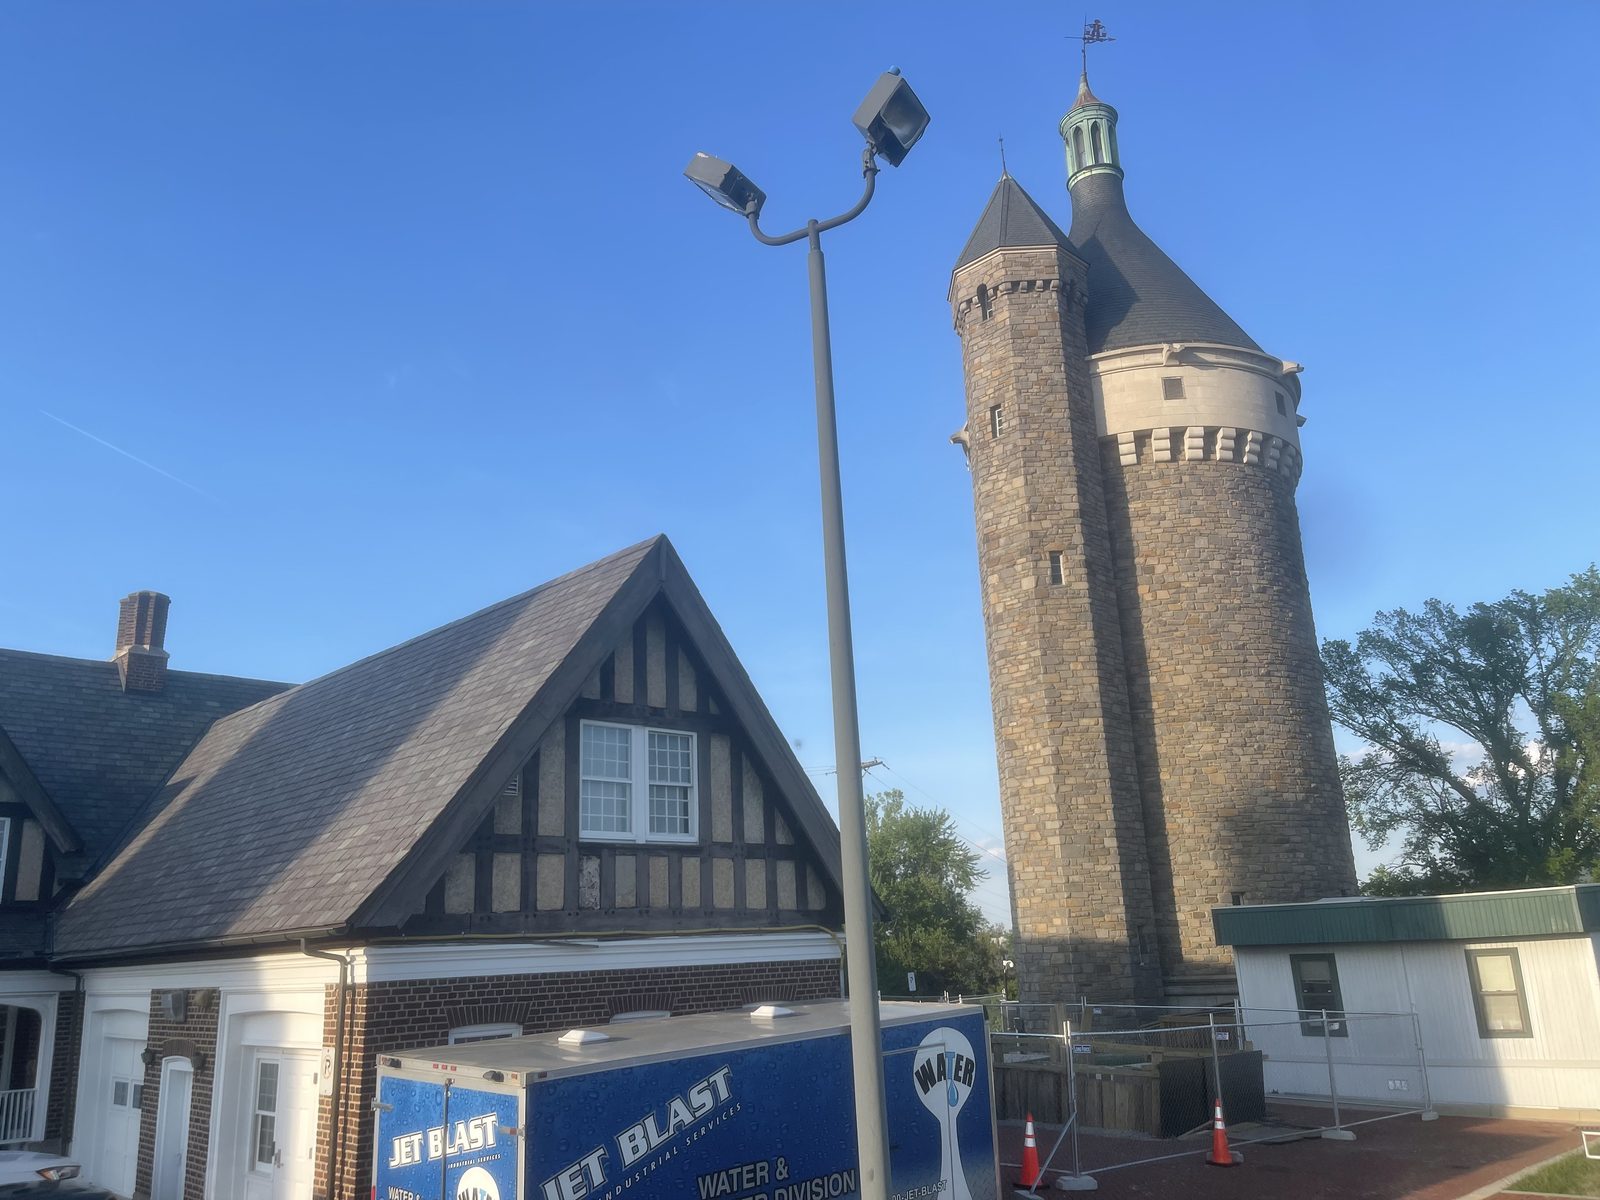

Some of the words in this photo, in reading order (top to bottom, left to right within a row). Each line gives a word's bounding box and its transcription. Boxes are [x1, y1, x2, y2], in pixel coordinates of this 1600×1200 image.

[914, 1051, 975, 1096] WATER
[614, 1064, 733, 1171] BLAST
[389, 1131, 424, 1170] JET
[427, 1112, 498, 1161] BLAST
[477, 1153, 501, 1163] SERVICES
[598, 1146, 678, 1200] NDUSTRIAL
[686, 1102, 742, 1146] SERVICES
[698, 1161, 769, 1200] WATER
[776, 1157, 788, 1181] &
[774, 1169, 856, 1200] DIVISION
